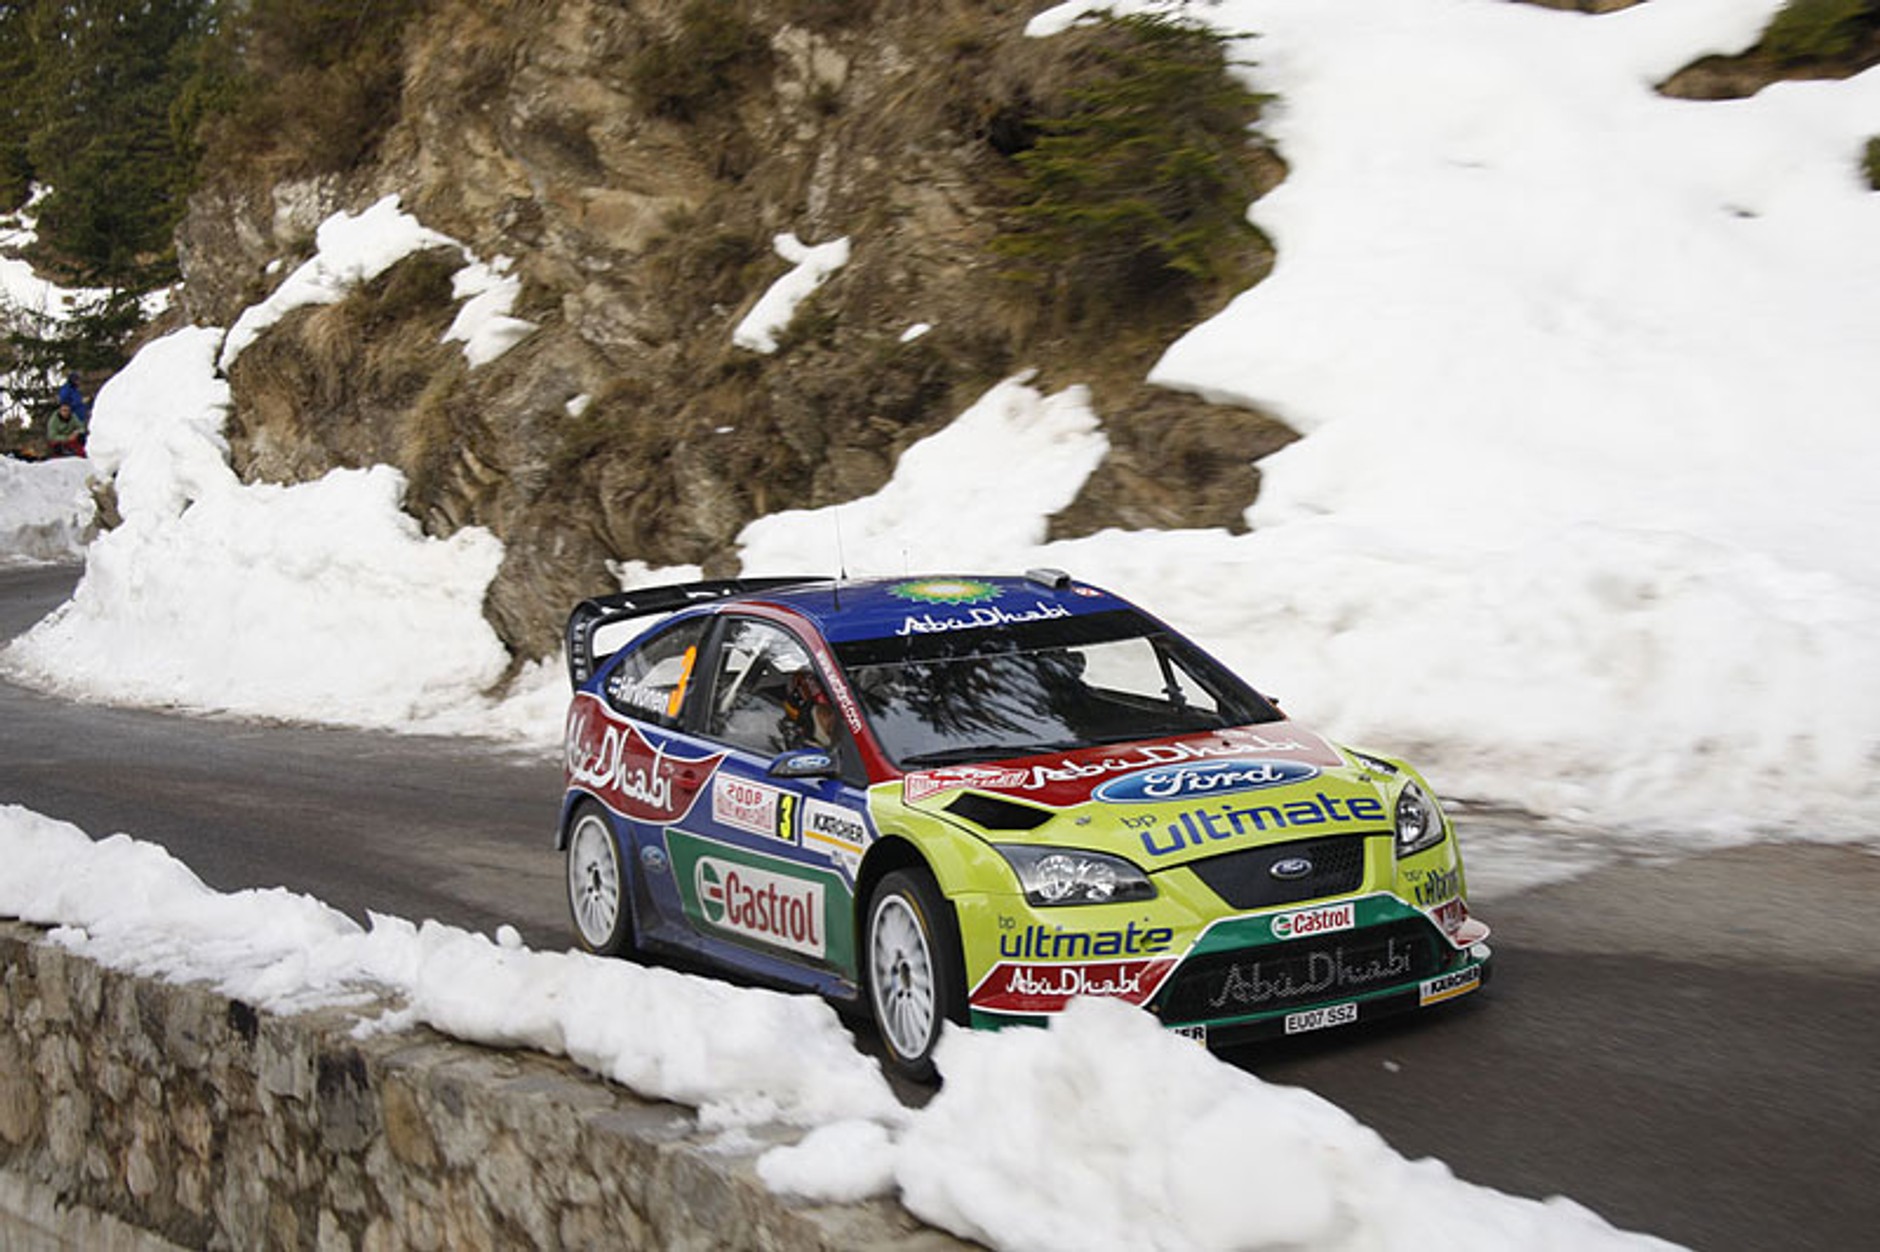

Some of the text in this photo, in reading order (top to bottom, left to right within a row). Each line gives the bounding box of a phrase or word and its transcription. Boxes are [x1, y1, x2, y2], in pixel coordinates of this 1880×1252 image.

[726, 783, 763, 806] 2008
[1144, 762, 1283, 796] Ford
[780, 795, 793, 839] 3
[1119, 814, 1157, 829] bp
[1140, 793, 1386, 855] ultimate
[726, 871, 818, 946] Castrol
[1293, 907, 1350, 934] Castrol
[1000, 920, 1173, 957] ultimate
[1288, 1005, 1355, 1030] EU07 SSZ
